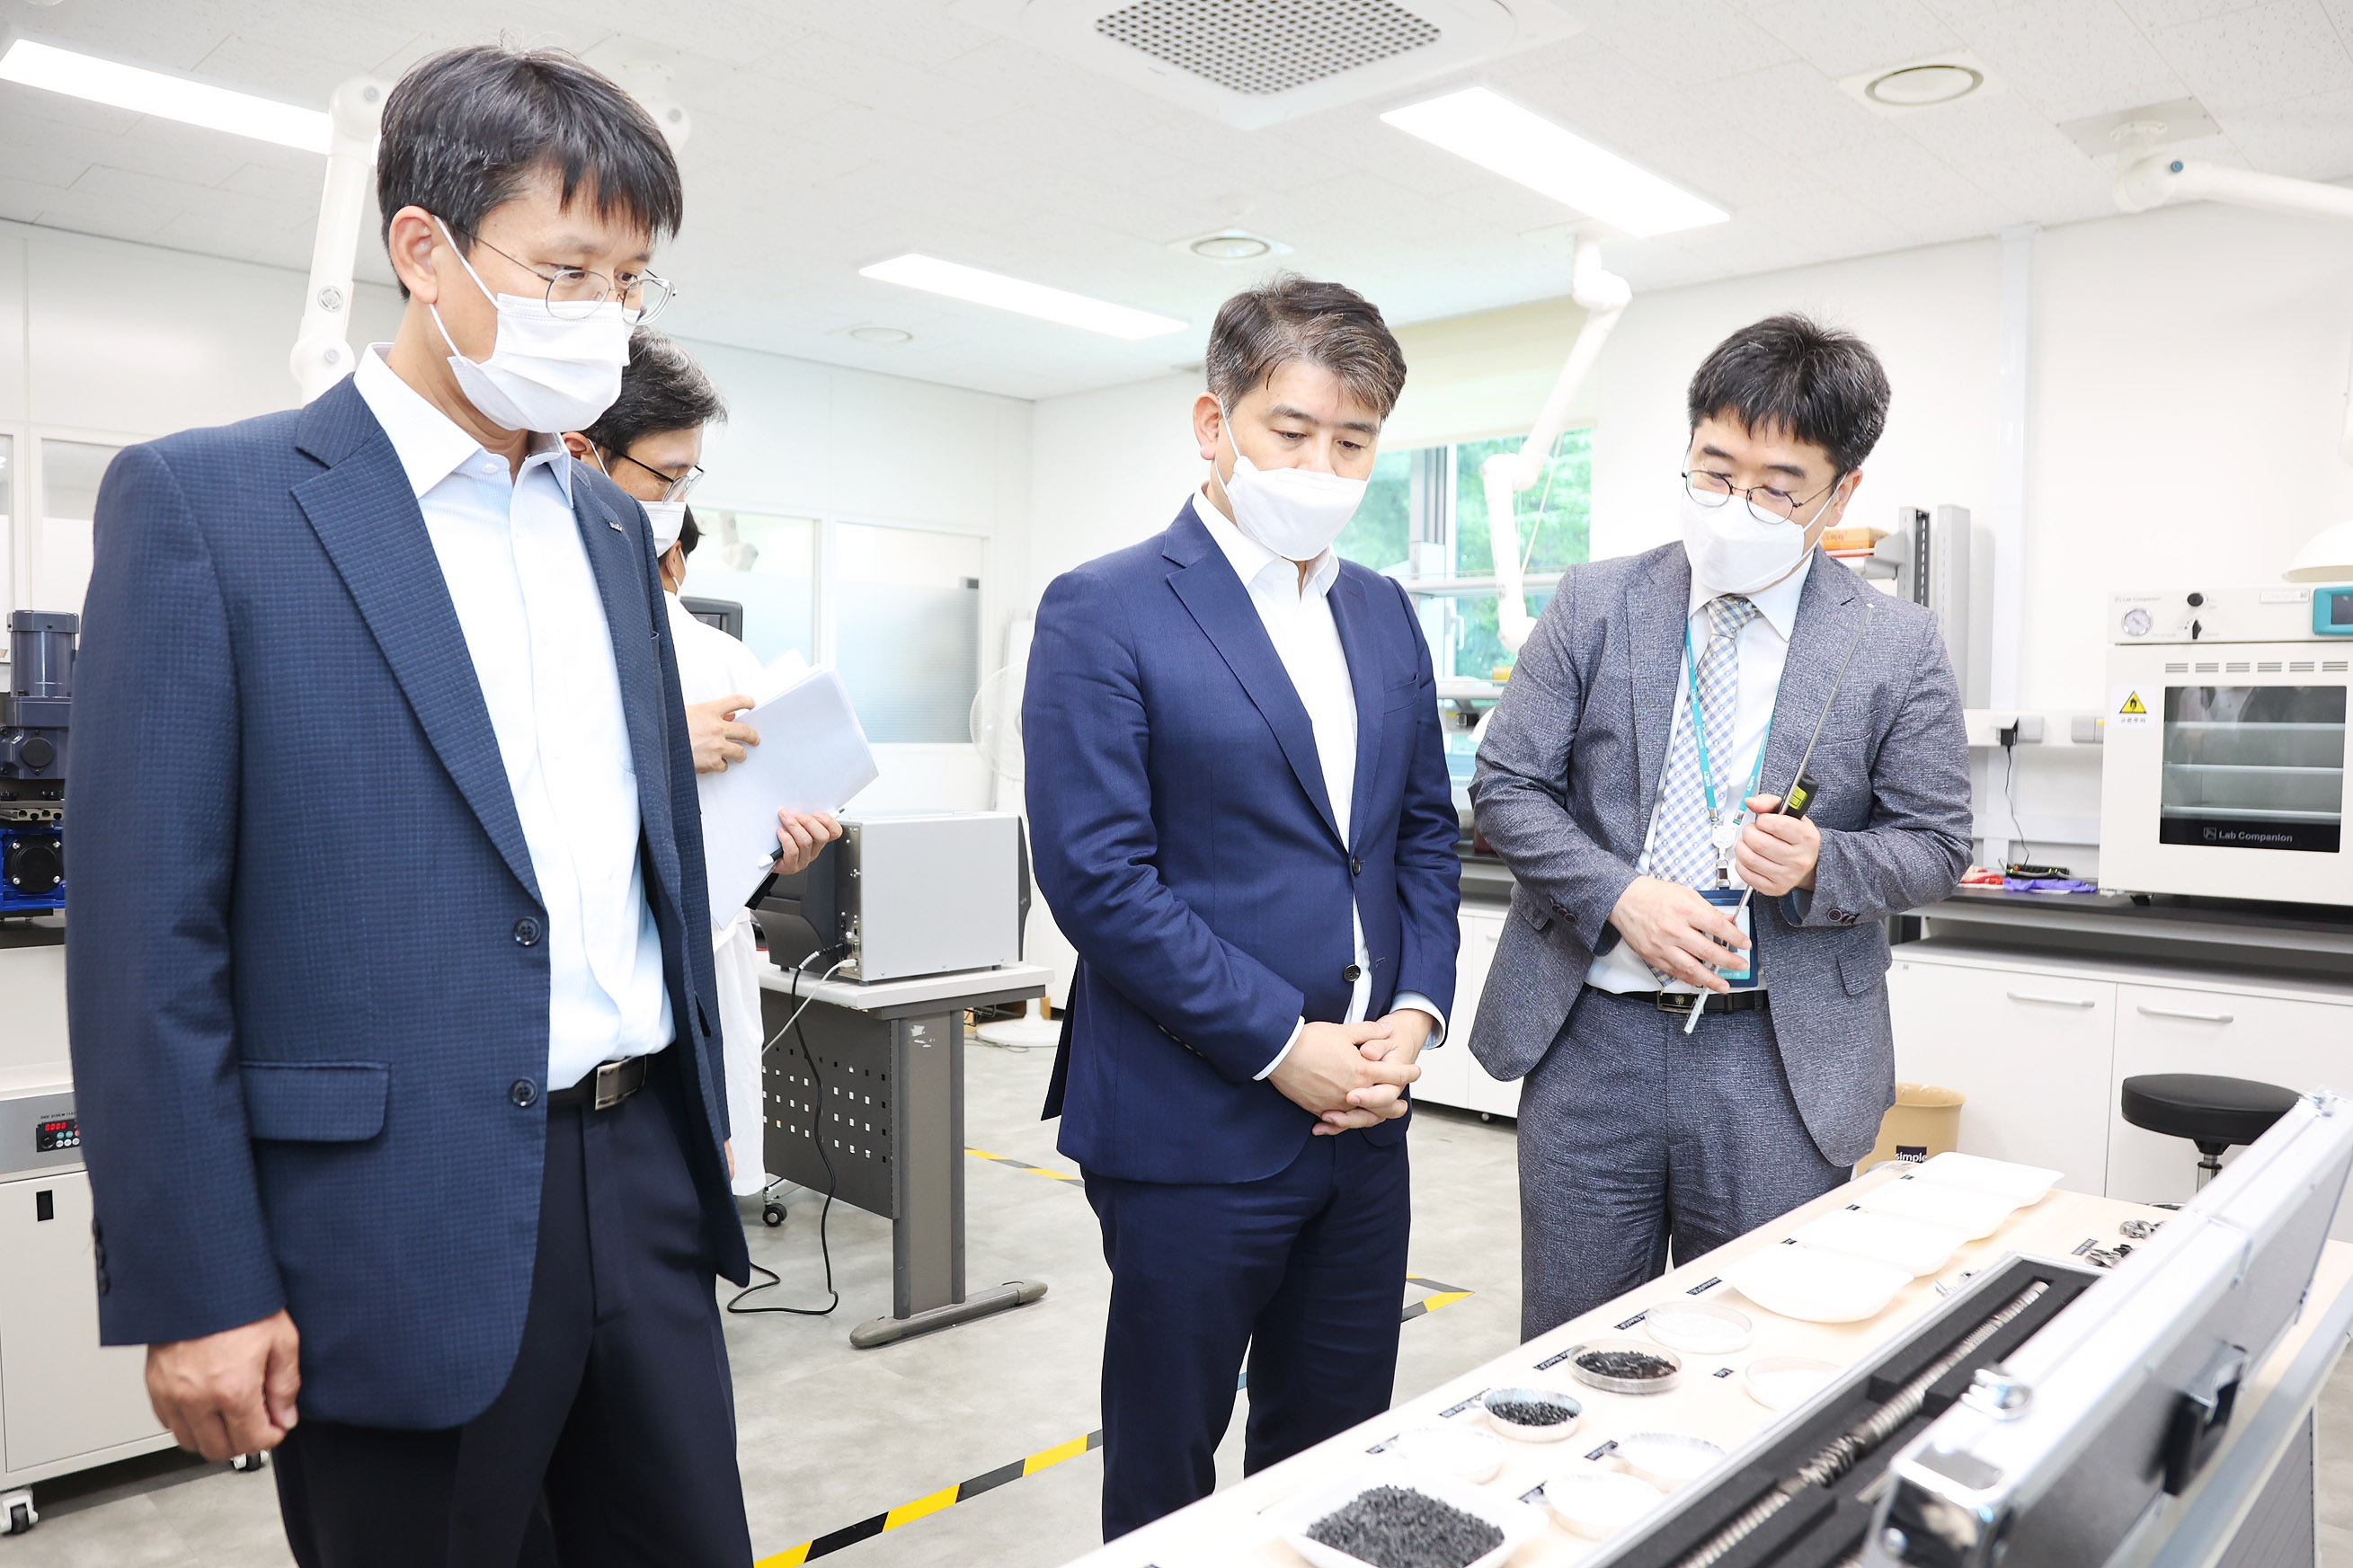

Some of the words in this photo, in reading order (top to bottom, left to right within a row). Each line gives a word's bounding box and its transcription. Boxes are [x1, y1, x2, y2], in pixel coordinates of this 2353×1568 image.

[2218, 830, 2237, 840] Lab
[2238, 831, 2294, 843] Companion
[1896, 1151, 1928, 1163] simple
